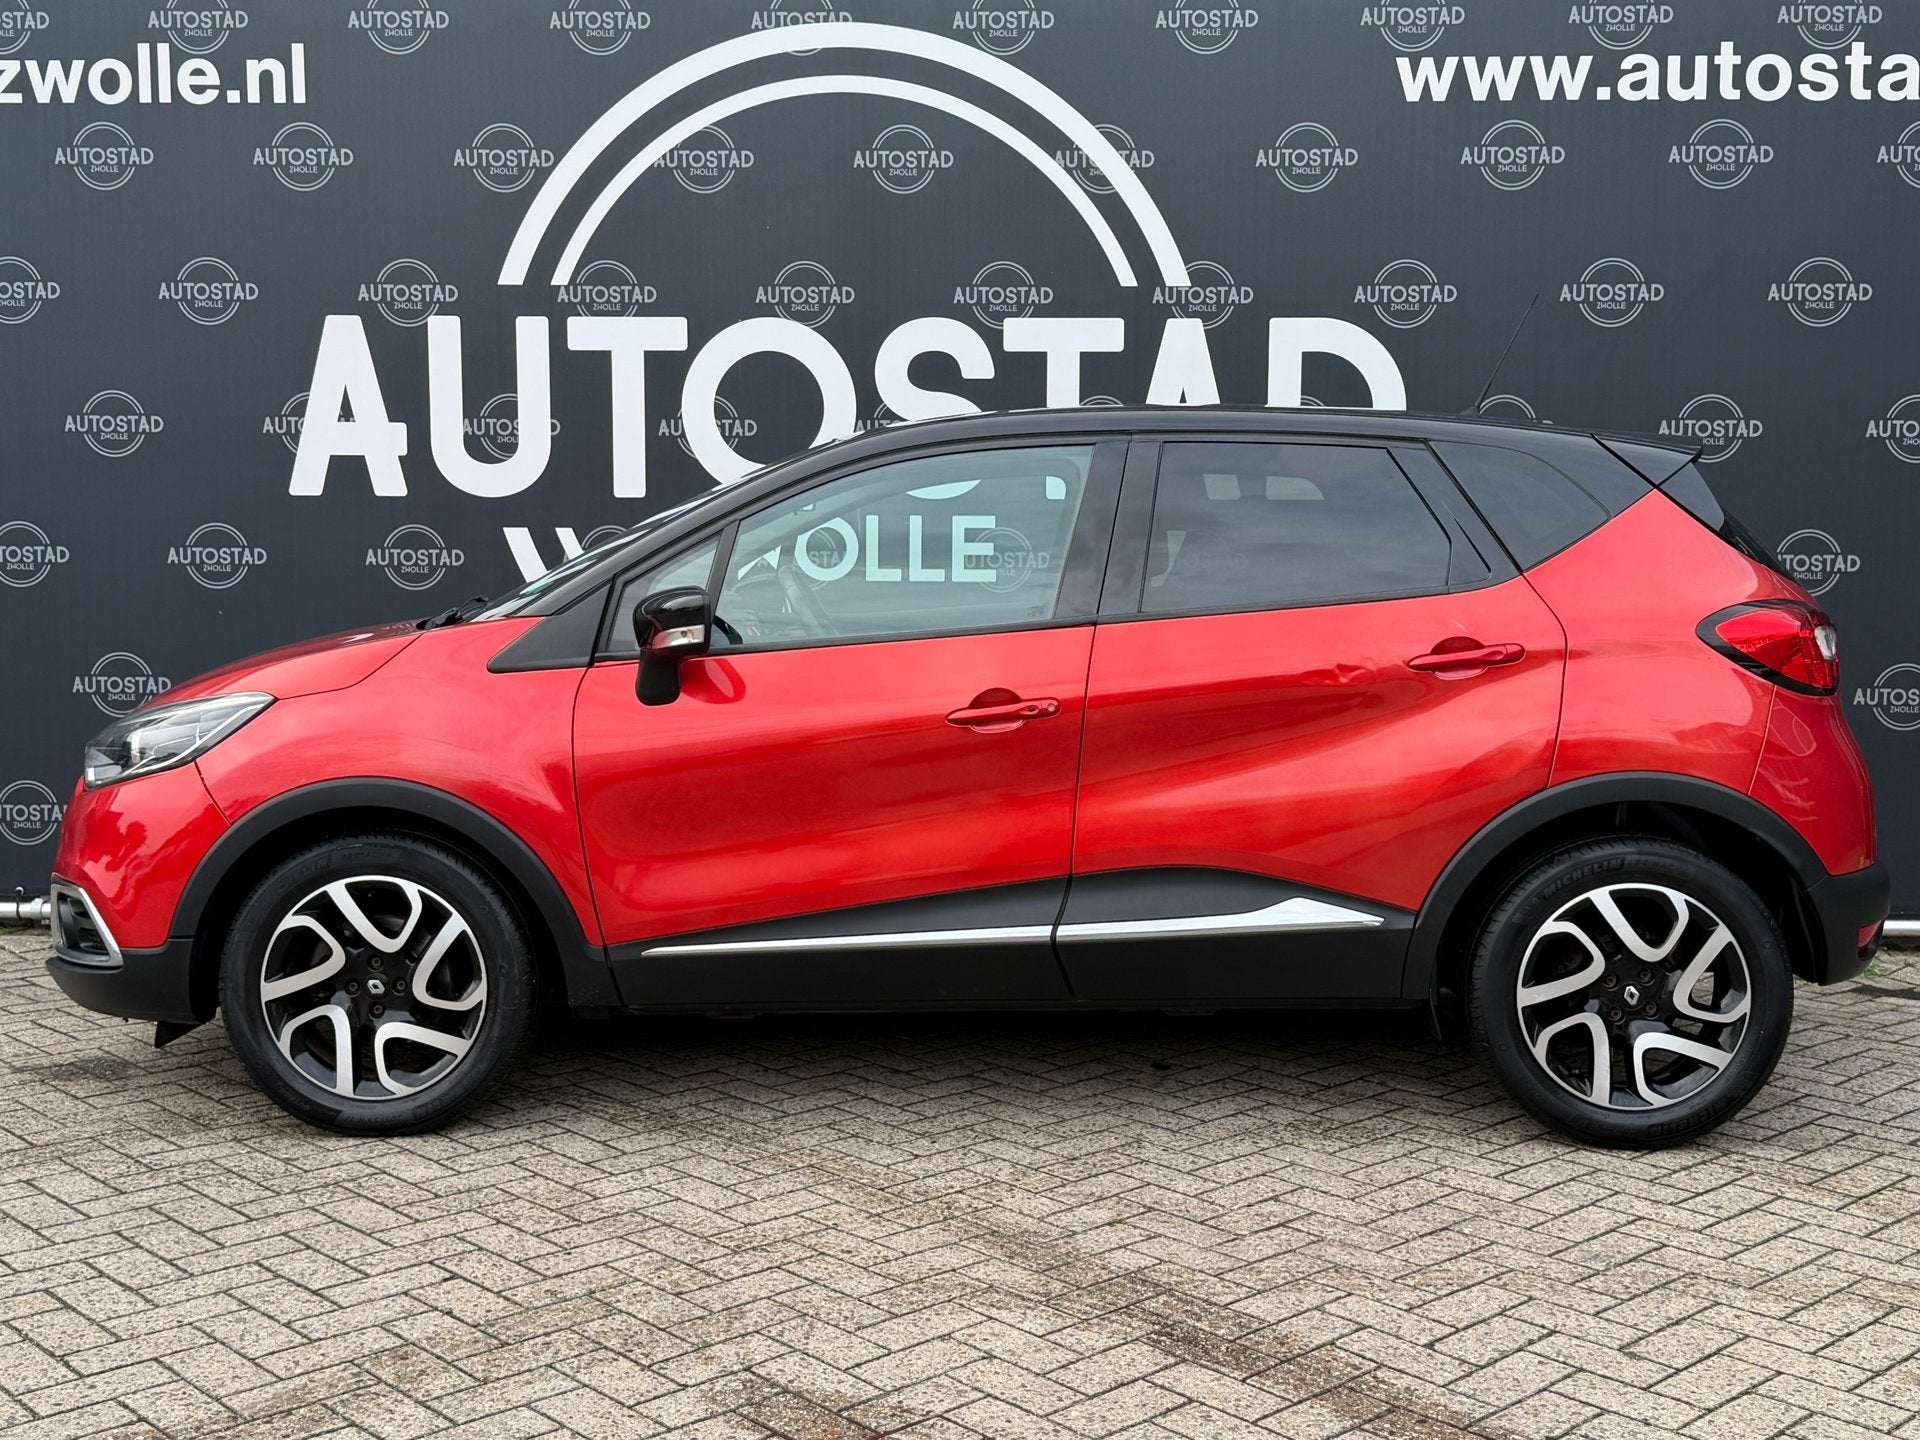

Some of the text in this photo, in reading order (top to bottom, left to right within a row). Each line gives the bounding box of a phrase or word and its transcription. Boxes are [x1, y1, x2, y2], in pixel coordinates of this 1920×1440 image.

[0, 12, 49, 29] STAD
[149, 11, 248, 28] AUTOSTAD
[348, 11, 449, 28] AUTOSTAD
[550, 11, 650, 29] AUTOSTAD
[953, 11, 1054, 29] AUTOSTAD
[1156, 10, 1258, 28] AUTOSTAD
[1361, 7, 1465, 25] AUTOSTAD
[1569, 5, 1673, 23] AUTOSTAD
[1778, 6, 1882, 23] AUTOSTAD
[0, 43, 306, 105] zwolle.nl
[1396, 41, 1920, 102] www.autosta
[55, 148, 153, 164] AUTOSTAD
[253, 148, 353, 165] AUTOSTAD
[454, 149, 554, 167] AUTOSTAD
[654, 151, 754, 168] AUTOSTAD
[854, 151, 953, 168] AUTOSTAD
[1055, 150, 1154, 168] AUTTAD
[1256, 149, 1358, 167] AUTOSTAD
[1461, 146, 1565, 164] AUTOSTAD
[1669, 146, 1773, 163] AUTOSTAD
[0, 282, 60, 298] OSTAD
[159, 283, 258, 300] AUTOSTAD
[358, 284, 458, 301] AUTOSTAD
[558, 286, 656, 303] AUTOSTAD
[756, 287, 855, 303] AUTOSTAD
[954, 287, 1053, 303] AUTOSTAD
[1152, 286, 1254, 304] AUTOSTAD
[1354, 285, 1457, 303] AUTOSTAD
[1560, 284, 1664, 301] AUTOSTAD
[1768, 284, 1872, 301] AUTOSTAD
[289, 315, 1406, 498] AUTOSTAD
[65, 415, 163, 432] AUTOSTAD
[263, 417, 304, 434] AUT
[463, 418, 560, 435] AUTOSD
[1659, 420, 1762, 437] AUTOSTAD
[1866, 420, 1919, 437] AUTO
[168, 547, 267, 564] AUTOSTAD
[366, 549, 464, 565] AUTOSTAD
[738, 515, 997, 583] OLLE
[965, 552, 1049, 570] UTOSTAD
[1778, 554, 1860, 572] TOSTAD
[73, 677, 171, 693] AUTOSTAD
[1853, 688, 1919, 705] AUTOS
[0, 805, 66, 821] TOSTA
[1544, 859, 1624, 896] MICHELIN
